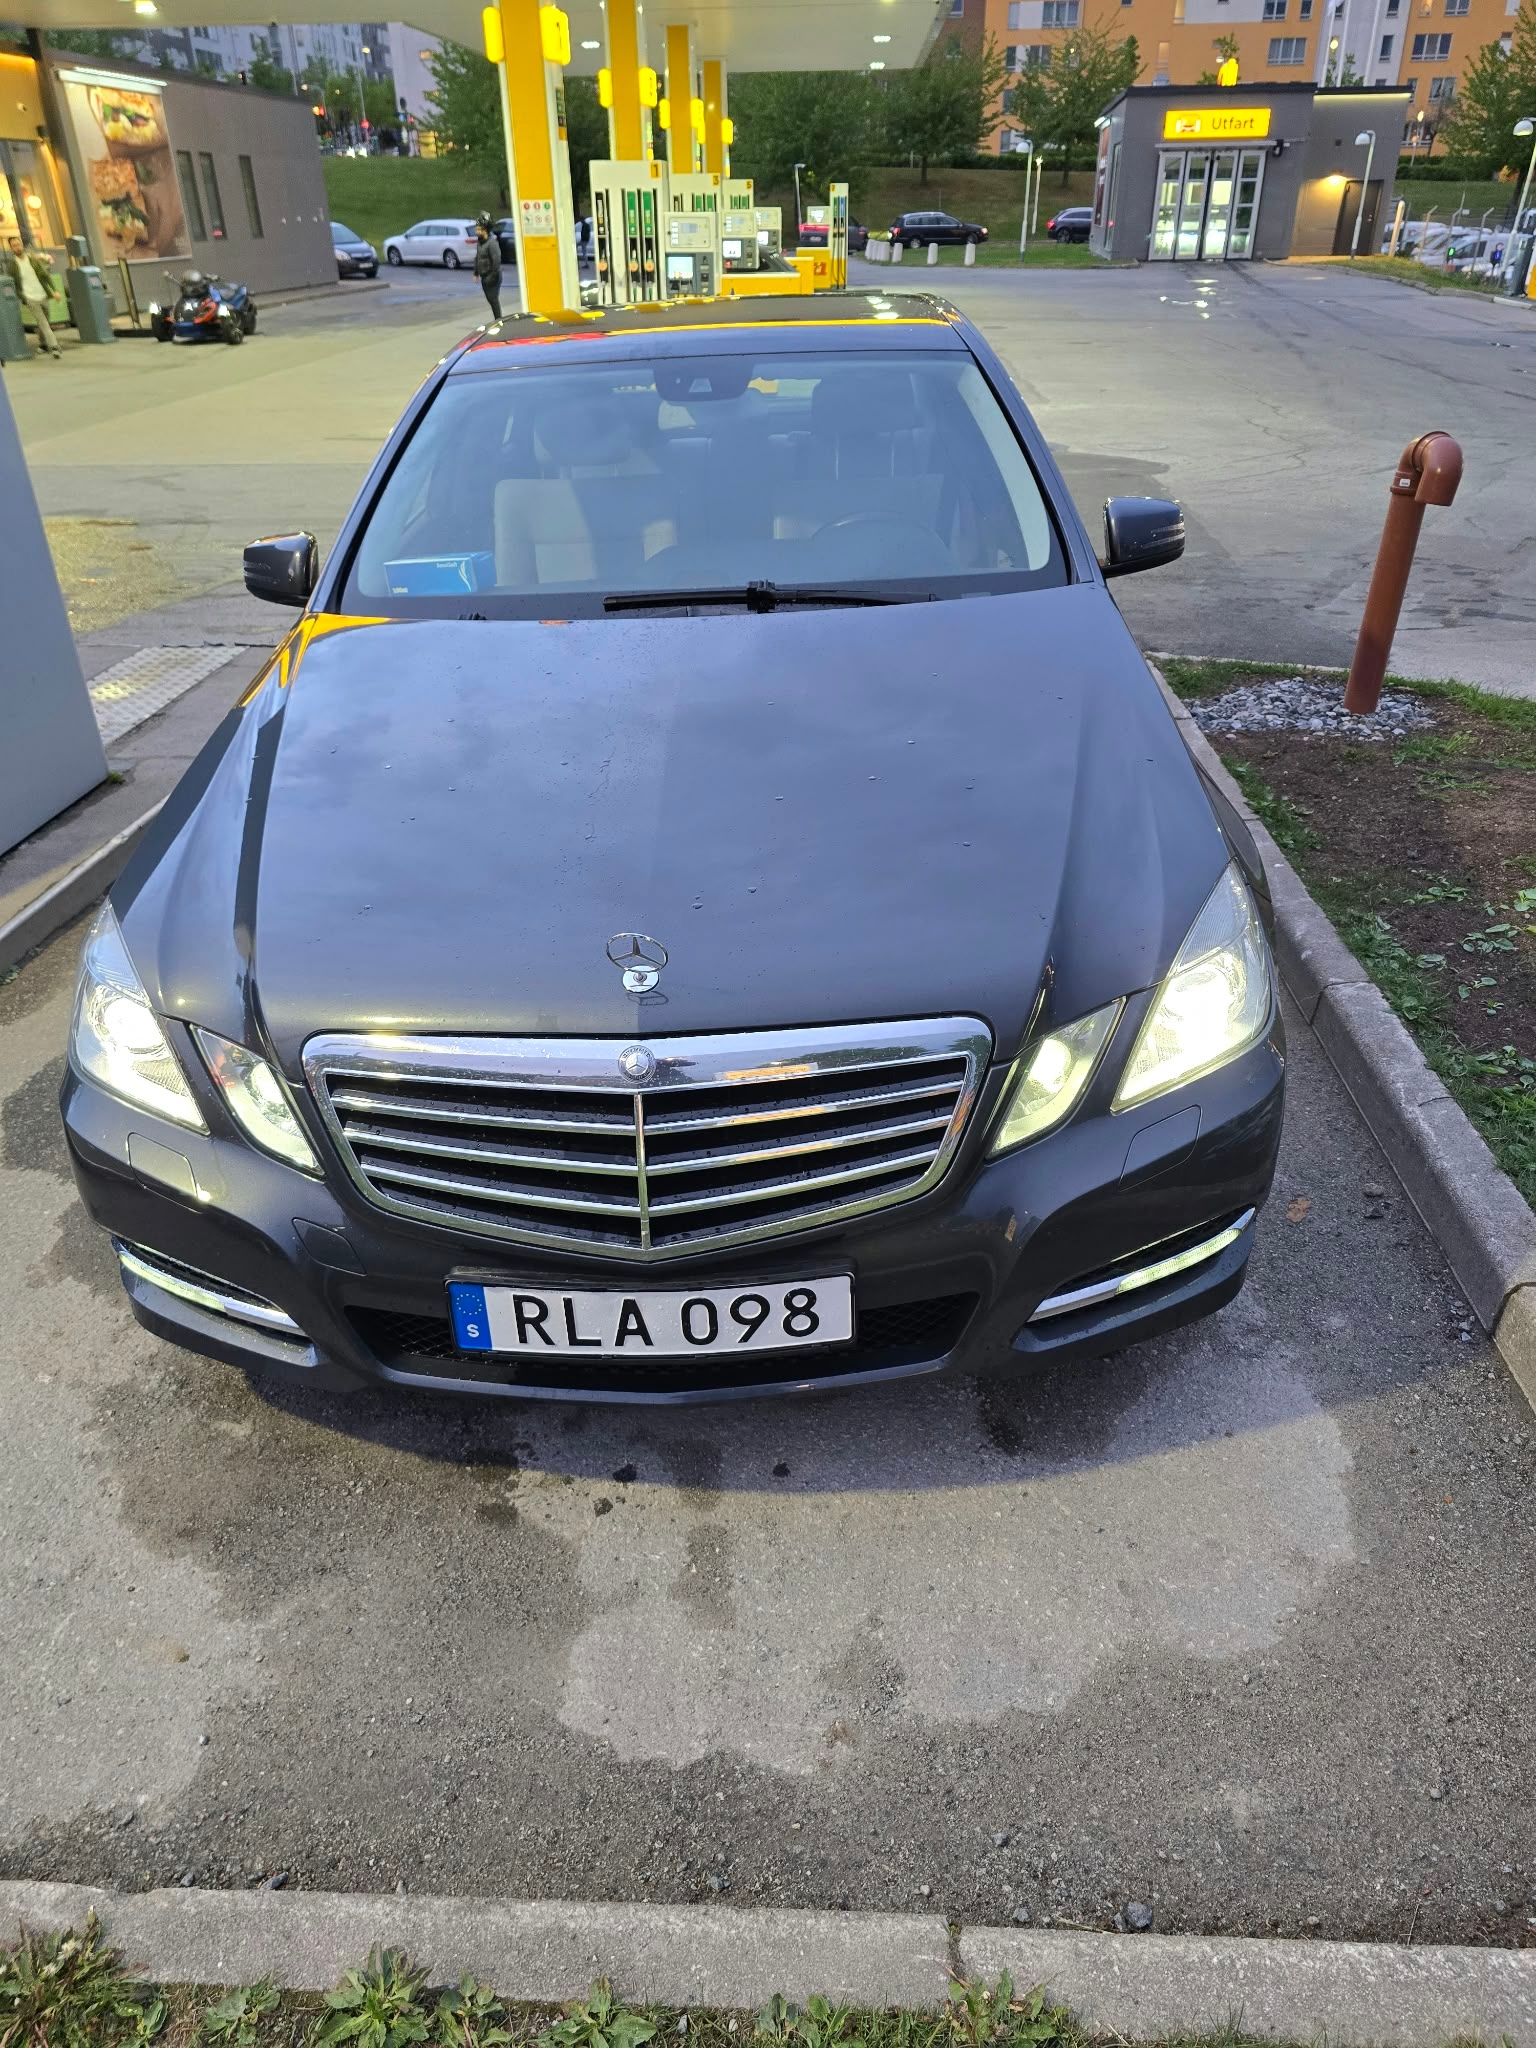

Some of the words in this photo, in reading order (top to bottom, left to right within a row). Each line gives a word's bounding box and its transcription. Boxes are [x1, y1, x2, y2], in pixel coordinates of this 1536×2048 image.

[1211, 117, 1255, 130] Utfart
[712, 175, 719, 185] 3
[466, 1323, 480, 1338] S
[512, 1294, 654, 1347] RLA
[680, 1287, 820, 1346] 098
